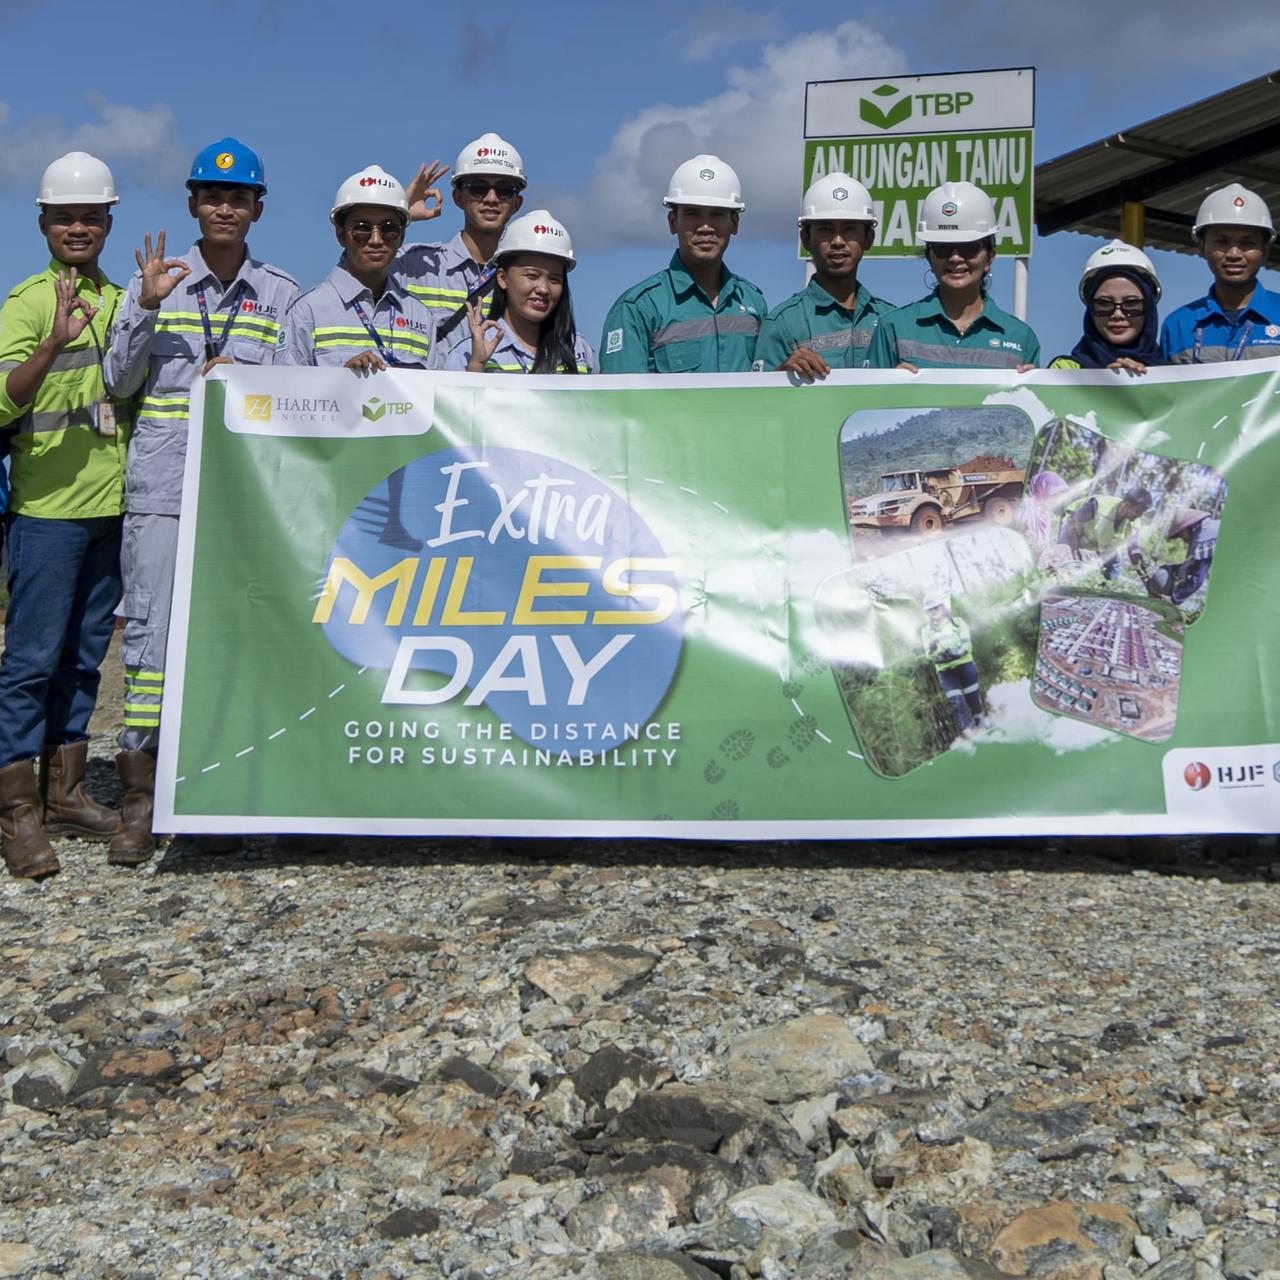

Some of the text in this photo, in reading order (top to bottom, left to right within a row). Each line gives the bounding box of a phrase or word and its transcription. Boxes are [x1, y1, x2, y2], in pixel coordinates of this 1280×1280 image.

[915, 91, 974, 116] TBP
[955, 136, 1026, 186] TAMU
[373, 177, 396, 188] HJF
[254, 302, 278, 315] HJF
[276, 398, 340, 413] HARITA
[387, 402, 413, 415] TBP
[281, 414, 337, 422] NICKEL
[426, 461, 613, 548] Extra
[311, 555, 686, 626] MILES
[380, 634, 637, 707] DAY
[343, 720, 682, 741] GOING THE DISTANCE
[348, 746, 677, 767] FOR SUSTAINABILITY
[1217, 765, 1265, 783] HJF
